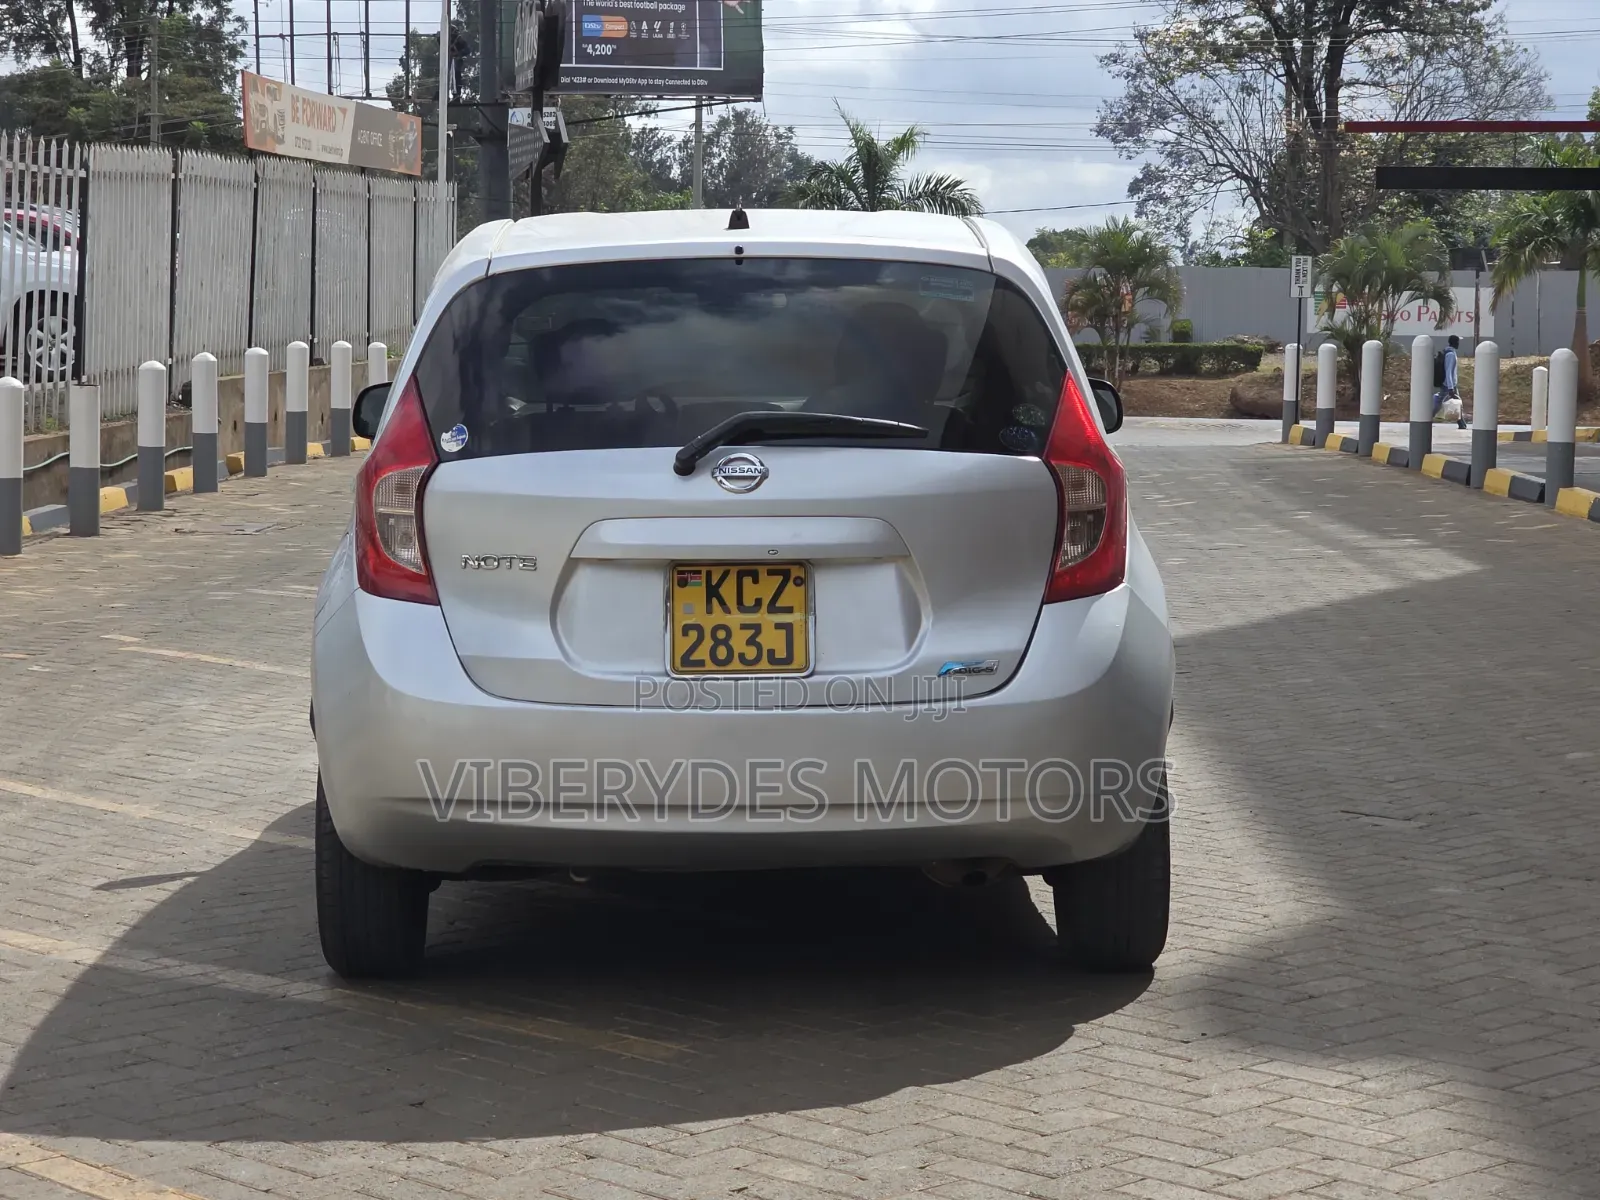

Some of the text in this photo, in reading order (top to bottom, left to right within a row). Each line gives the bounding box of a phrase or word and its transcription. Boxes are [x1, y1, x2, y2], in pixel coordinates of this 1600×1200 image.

[619, 0, 633, 8] best
[634, 0, 657, 9] football
[658, 3, 686, 13] package
[605, 23, 625, 31] Compact
[586, 44, 613, 56] 4,200
[618, 78, 637, 86] MyDStv
[638, 78, 648, 87] App
[654, 79, 664, 87] stay
[291, 94, 336, 132] BE FORWARD
[1417, 305, 1474, 323] PANTS
[717, 467, 762, 475] NISSAN
[461, 554, 537, 571] NOTE
[705, 568, 794, 615] KCZ
[680, 622, 794, 668] 283J
